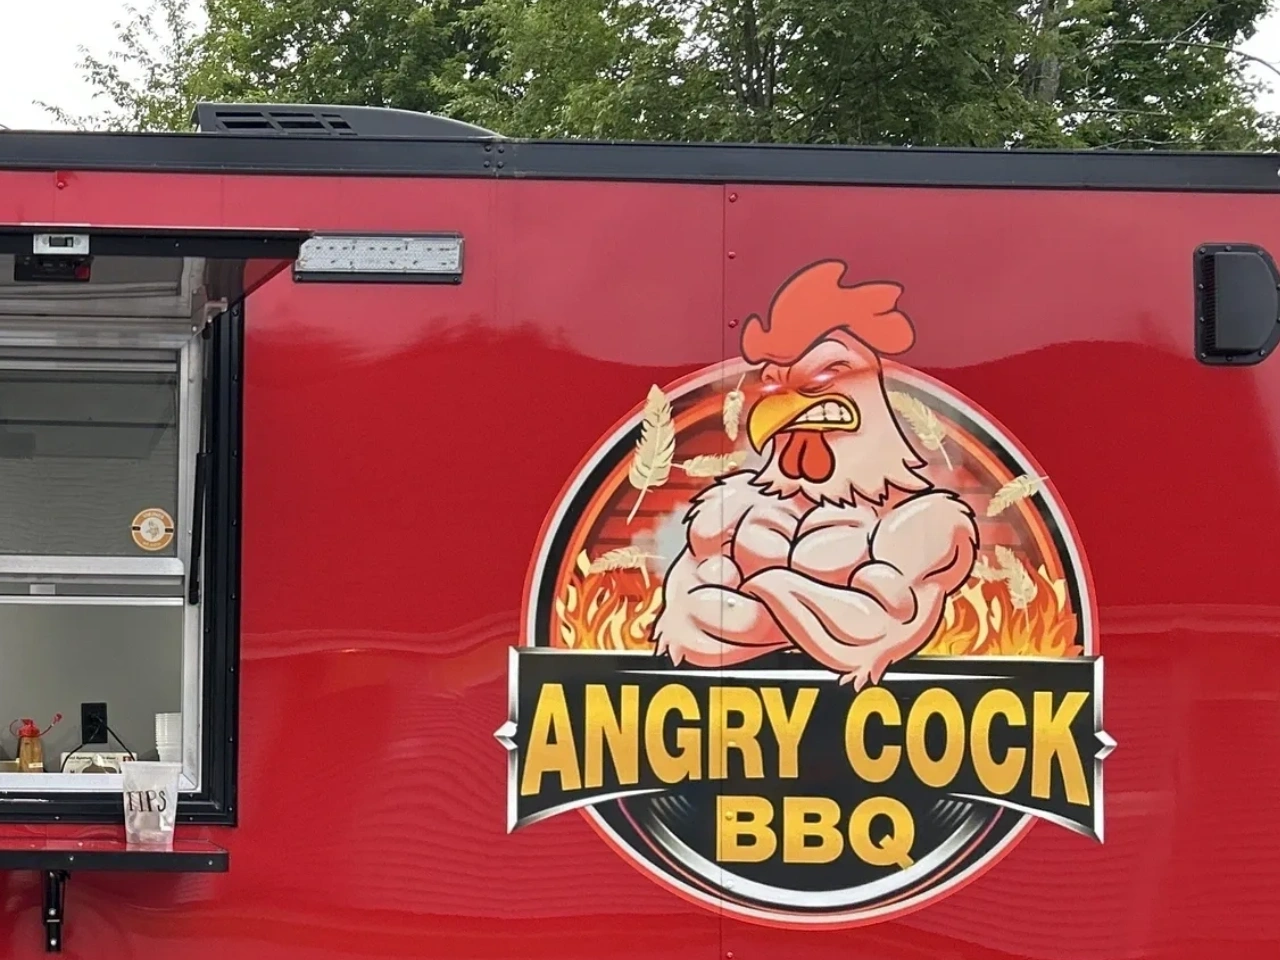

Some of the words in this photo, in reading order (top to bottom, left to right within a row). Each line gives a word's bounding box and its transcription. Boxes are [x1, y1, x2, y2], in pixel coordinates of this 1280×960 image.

[520, 683, 820, 796] ANGRY
[844, 687, 1091, 806] COCK
[127, 789, 167, 813] TIPS
[715, 795, 915, 869] BBQ
